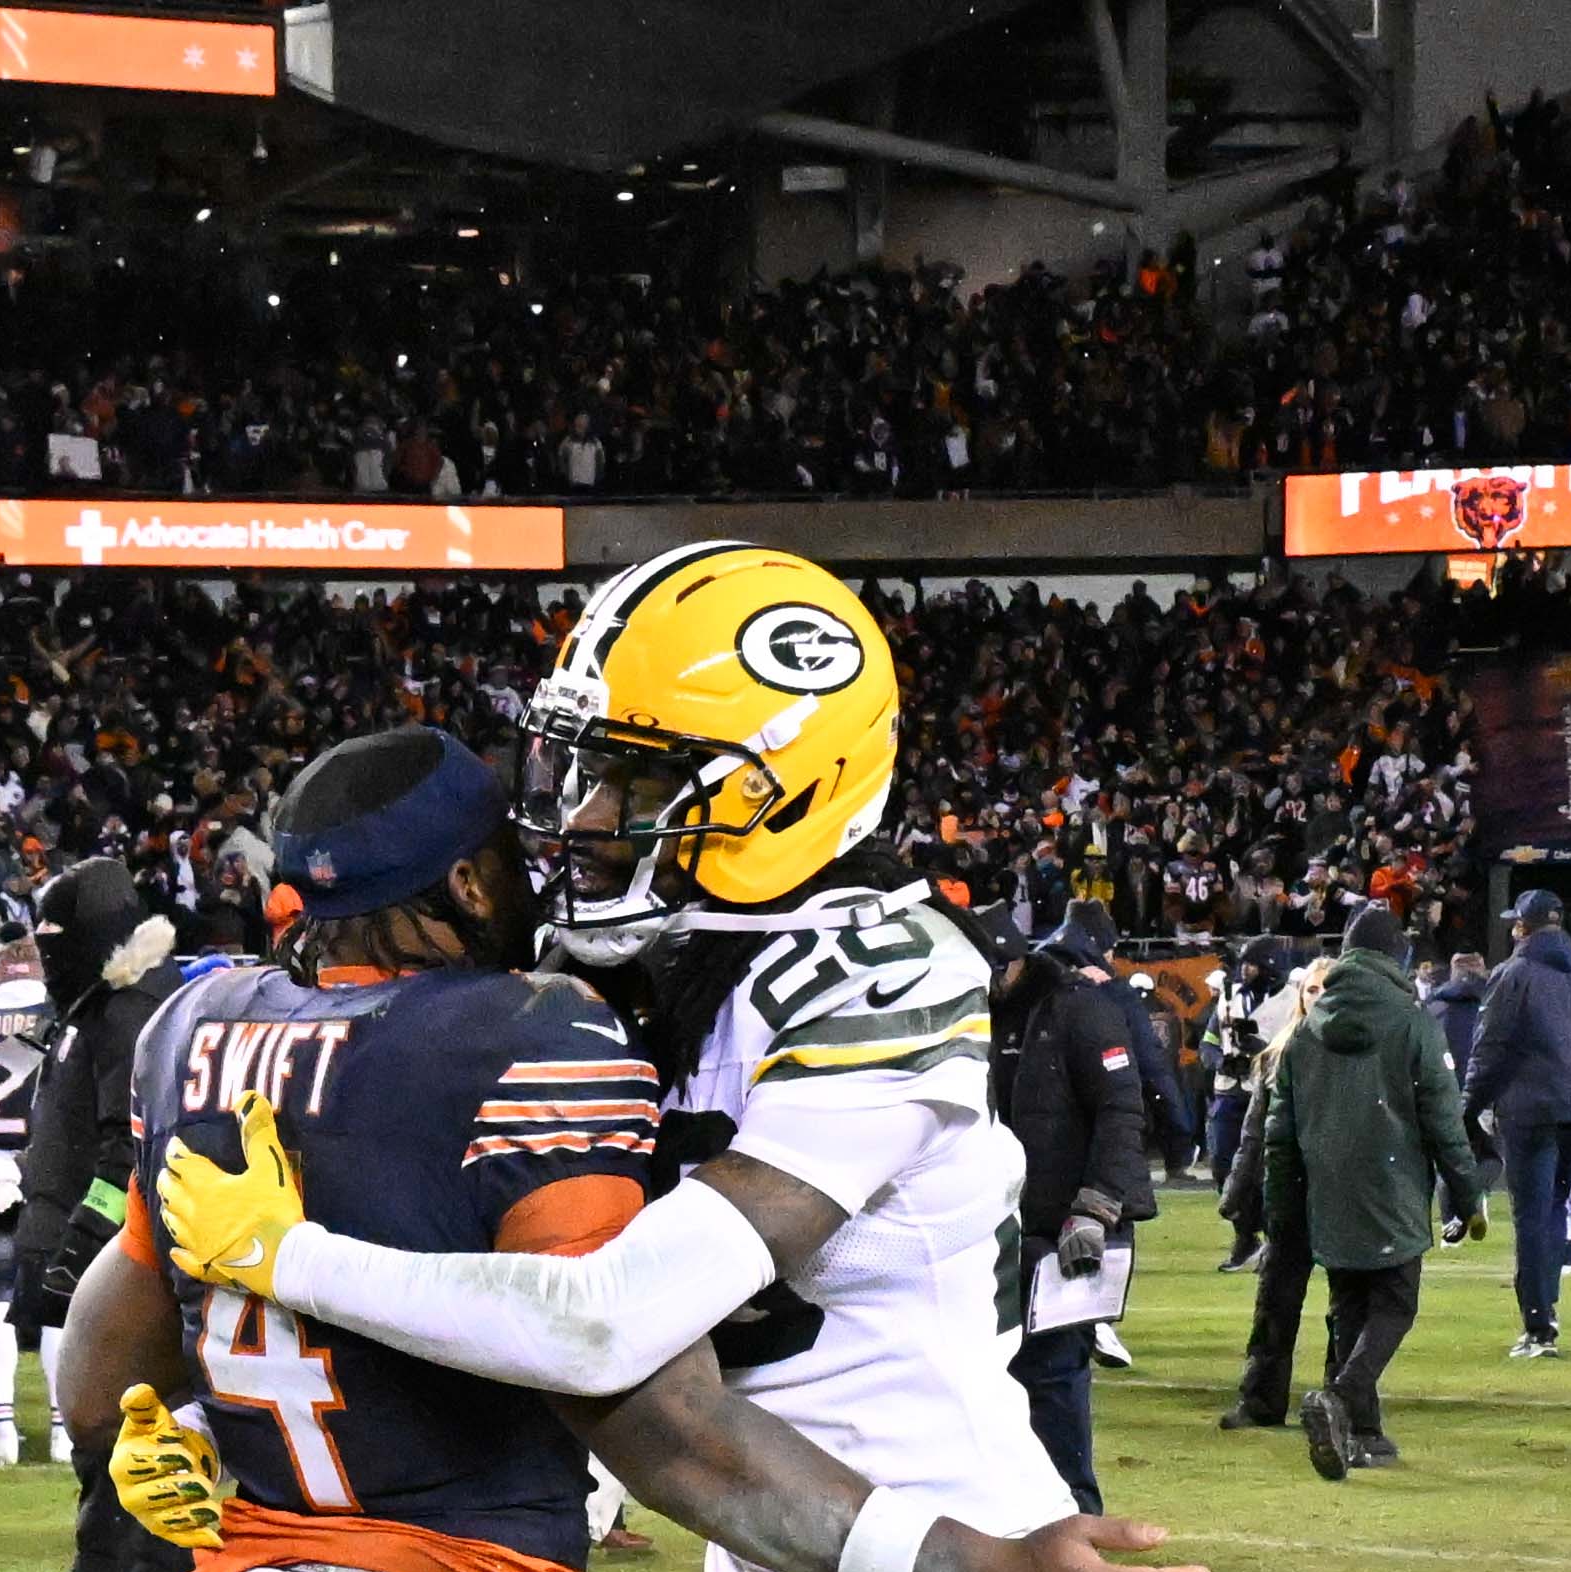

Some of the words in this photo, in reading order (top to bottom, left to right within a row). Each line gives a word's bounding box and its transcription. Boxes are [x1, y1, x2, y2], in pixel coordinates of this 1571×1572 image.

[121, 516, 248, 549] Advocate
[251, 520, 339, 550] Health
[342, 521, 406, 552] Care
[1185, 875, 1209, 902] 46
[183, 1019, 353, 1117] SWIFT
[196, 1151, 363, 1514] 4
